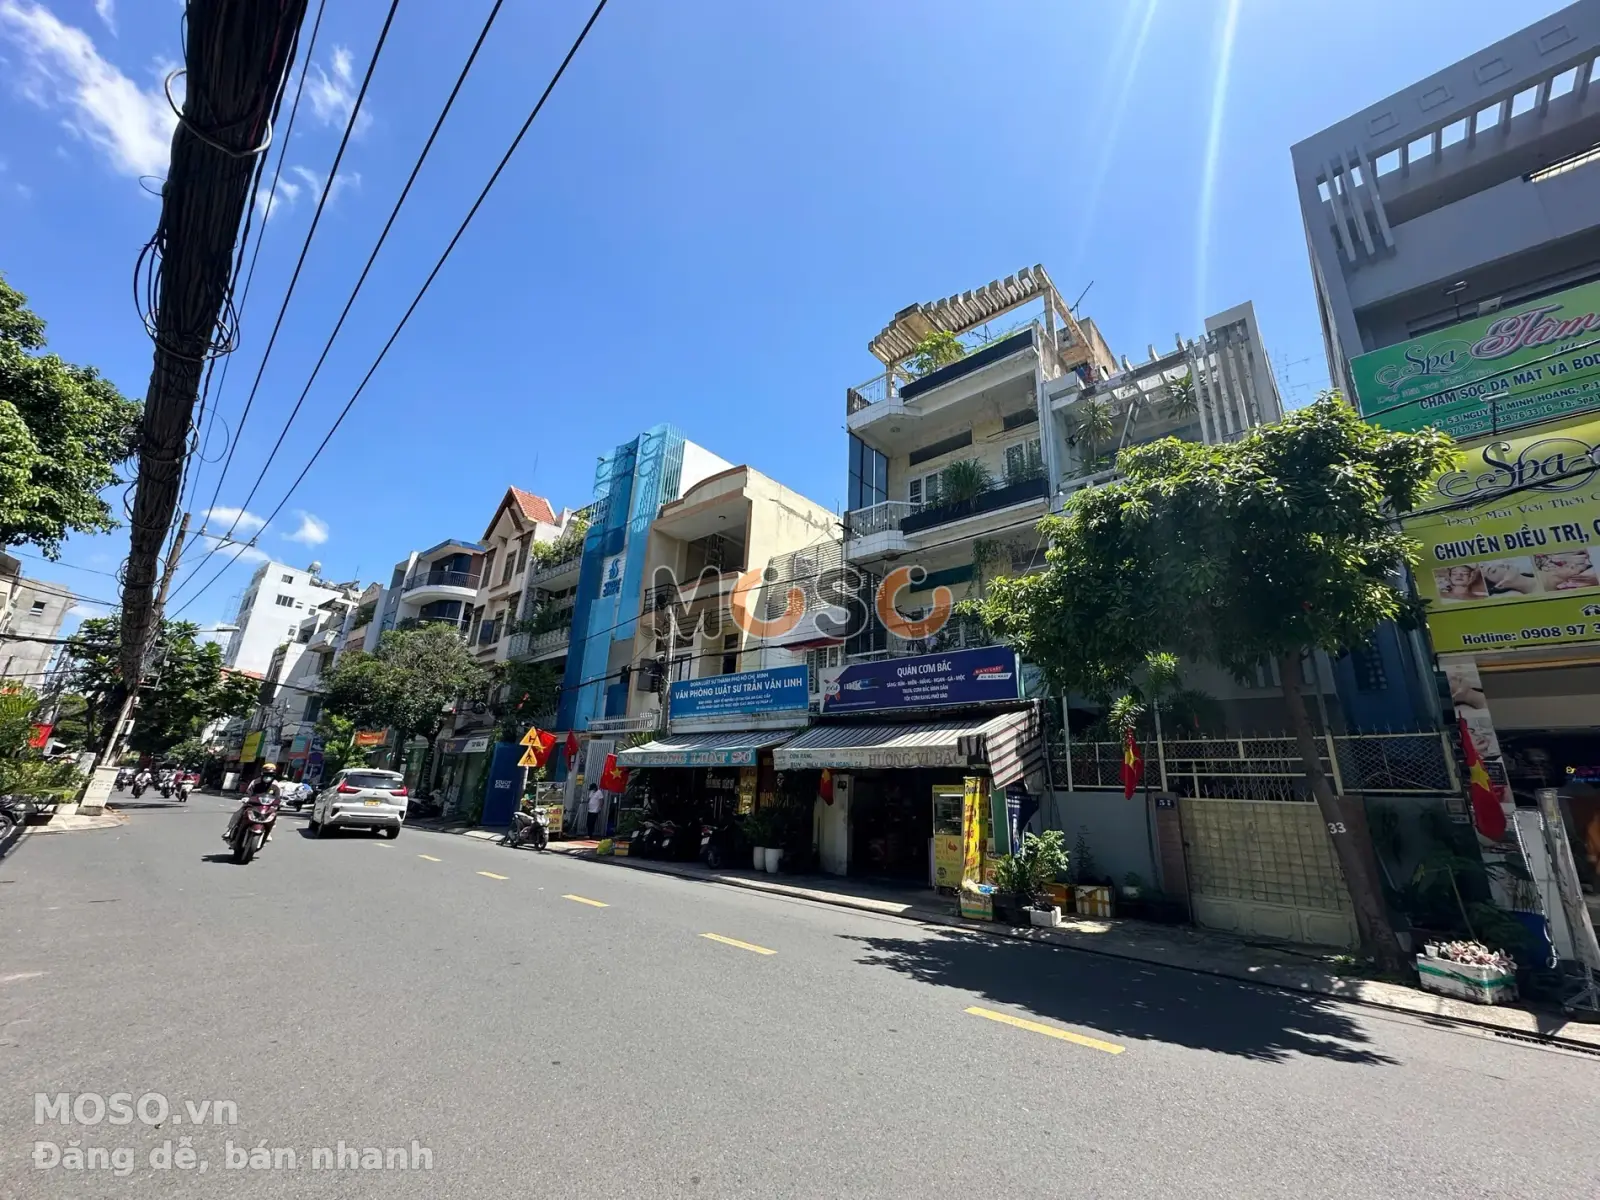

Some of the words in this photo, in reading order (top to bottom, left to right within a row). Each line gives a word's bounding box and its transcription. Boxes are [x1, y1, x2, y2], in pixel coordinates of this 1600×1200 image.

[1490, 378, 1510, 391] DA
[1548, 360, 1569, 376] VÀ
[1447, 416, 1459, 424] 53
[1506, 398, 1534, 410] MINH
[1472, 421, 1483, 430] 25
[1514, 411, 1526, 419] 76
[1526, 408, 1539, 417] 33
[1541, 404, 1553, 413] 16
[1434, 534, 1500, 561] CHUYÊN
[1503, 524, 1547, 550] ĐIỀU
[1462, 632, 1517, 645] Hotline:
[1521, 626, 1562, 640] 0908
[1566, 624, 1586, 636] 97
[897, 664, 918, 678] QUÁN
[918, 664, 936, 676] CƠM
[937, 659, 952, 673] BẮC
[675, 689, 689, 700] VĂN
[689, 687, 714, 698] PHÒNG
[715, 685, 731, 697] LUẬT
[732, 684, 742, 693] SƯ
[743, 679, 763, 692] TRẦN
[764, 678, 782, 690] VĂN
[783, 677, 803, 688] LINH
[1327, 822, 1347, 834] 33
